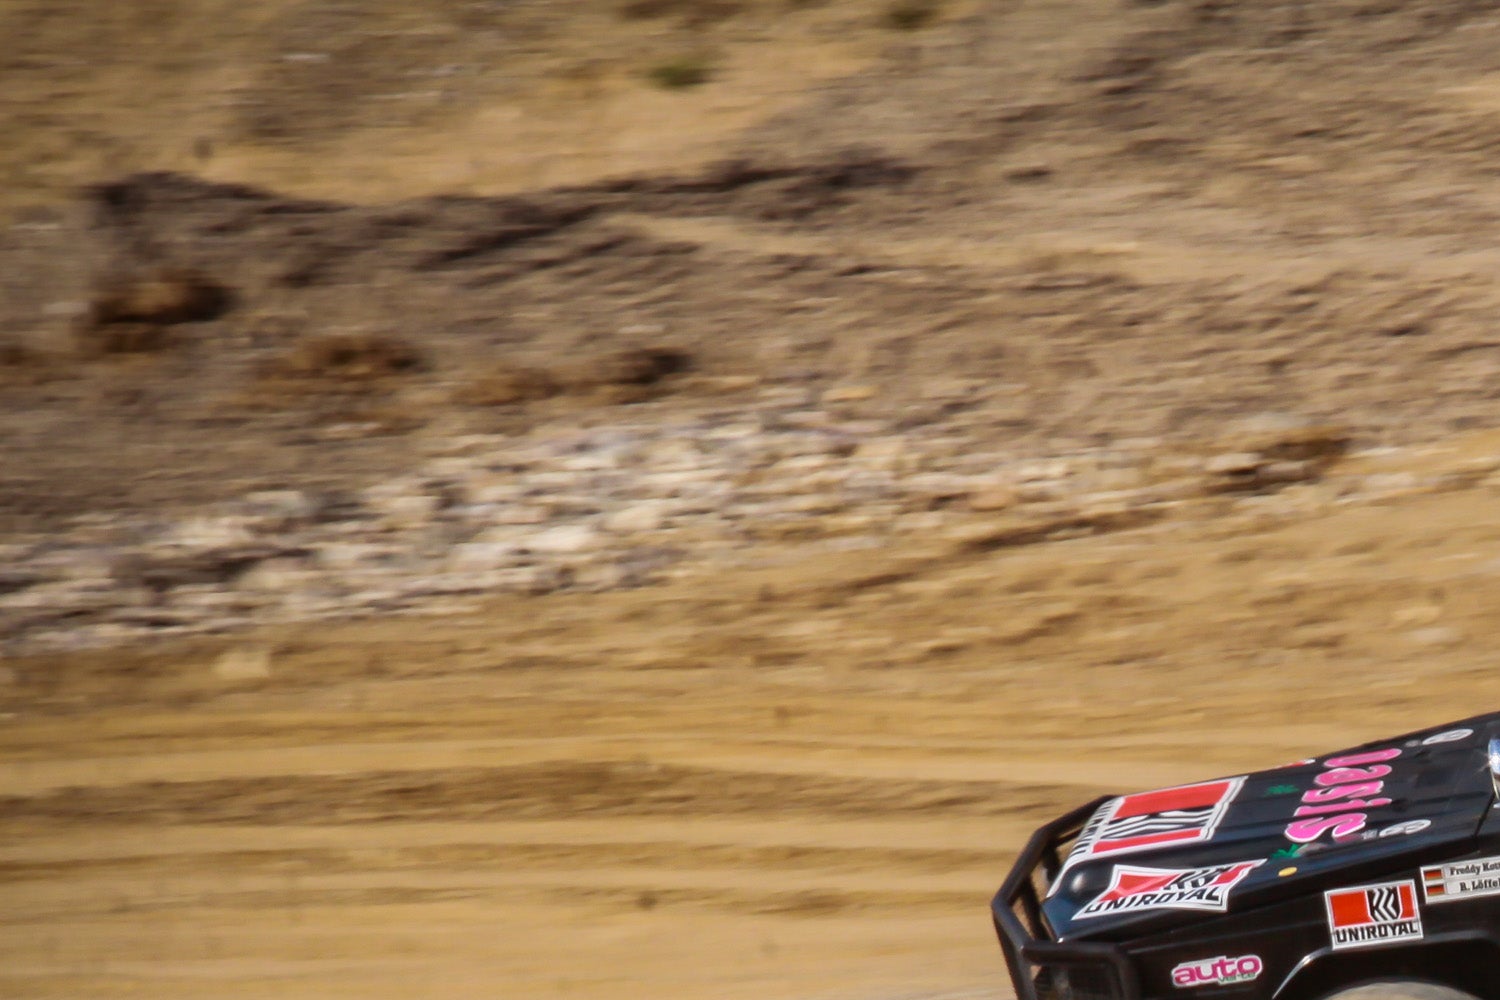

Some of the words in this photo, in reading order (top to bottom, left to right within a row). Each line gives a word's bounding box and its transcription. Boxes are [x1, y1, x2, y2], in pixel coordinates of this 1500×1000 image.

[1450, 864, 1480, 876] Freddy
[1084, 886, 1221, 914] UNIROYAL
[1335, 921, 1418, 944] UNIROYAL
[1174, 957, 1261, 985] auto
